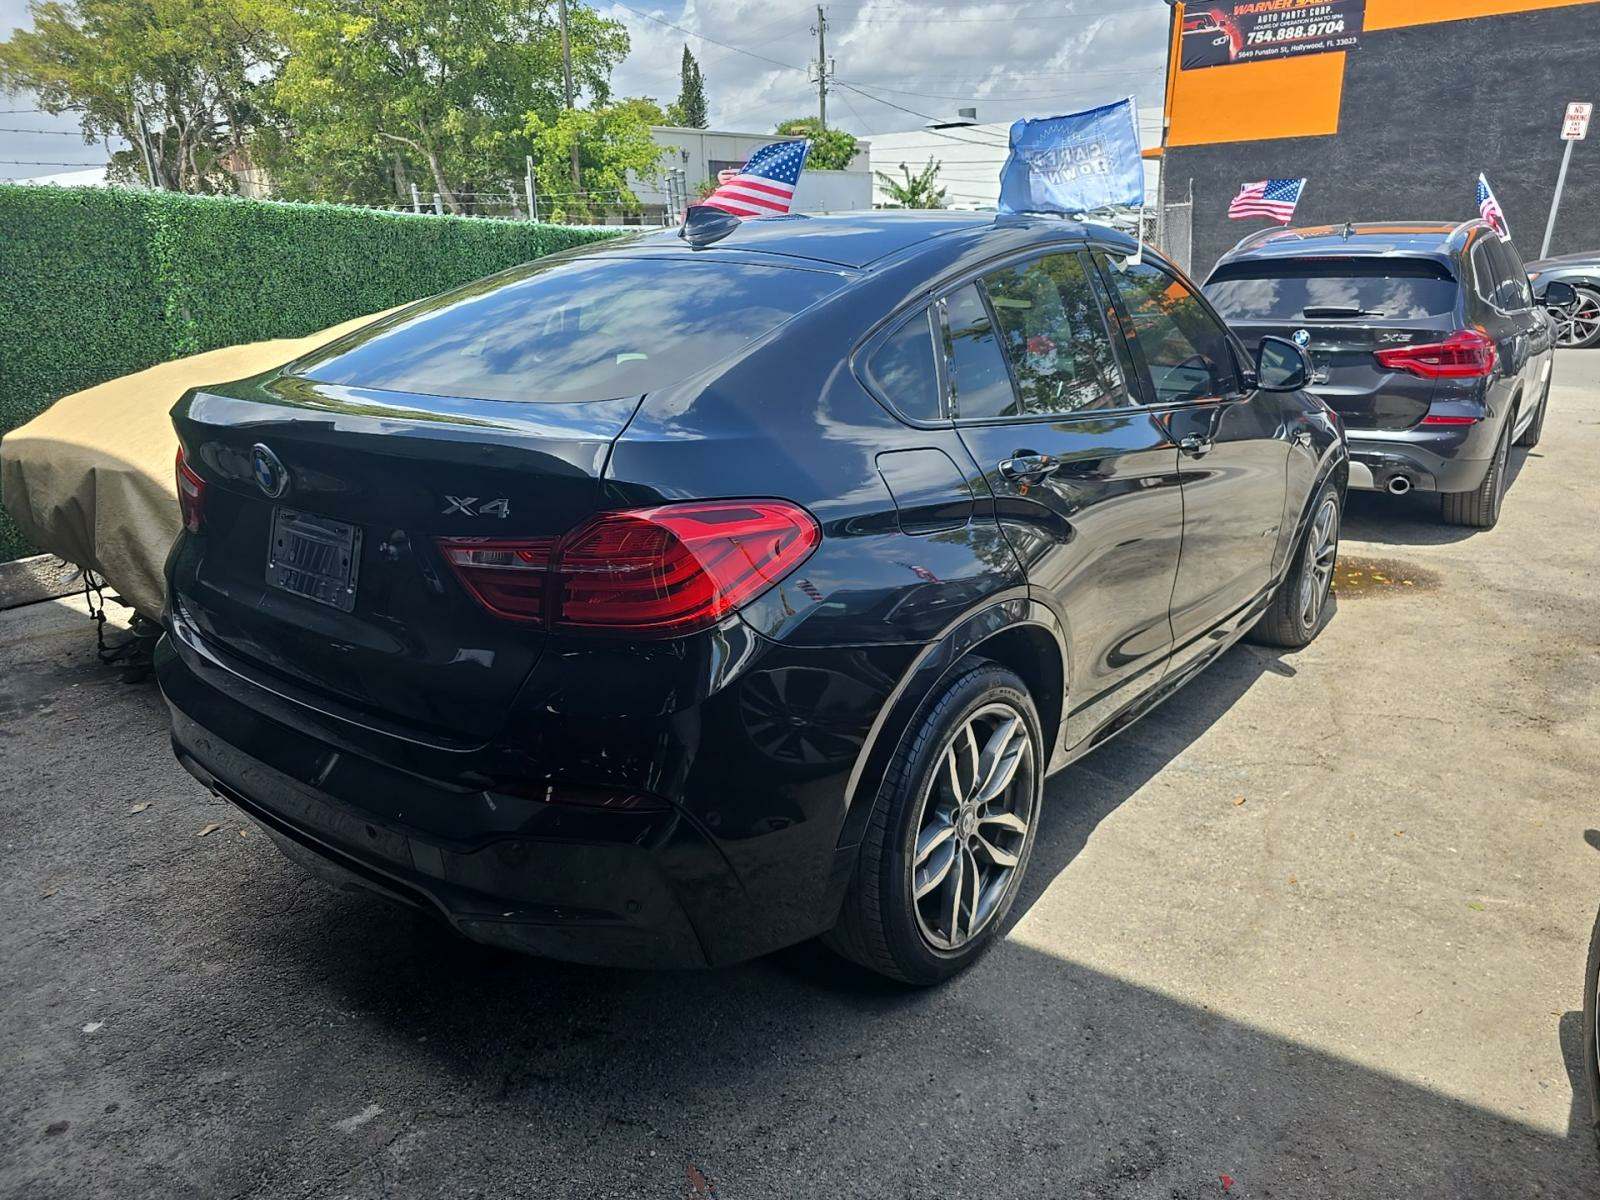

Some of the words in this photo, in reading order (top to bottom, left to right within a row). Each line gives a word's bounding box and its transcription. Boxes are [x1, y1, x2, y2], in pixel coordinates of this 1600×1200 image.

[1233, 0, 1292, 15] WARNER
[1258, 13, 1278, 23] AUTO
[1281, 8, 1307, 20] PARTS
[1309, 5, 1333, 16] CORP.
[1279, 18, 1309, 27] OPERATION
[1246, 20, 1345, 45] 754.888.9704
[1238, 50, 1254, 58] 5649
[1255, 48, 1279, 56] Funston
[1291, 41, 1325, 53] Hollywood,
[1336, 37, 1357, 46] 33023
[441, 495, 510, 518] X4
